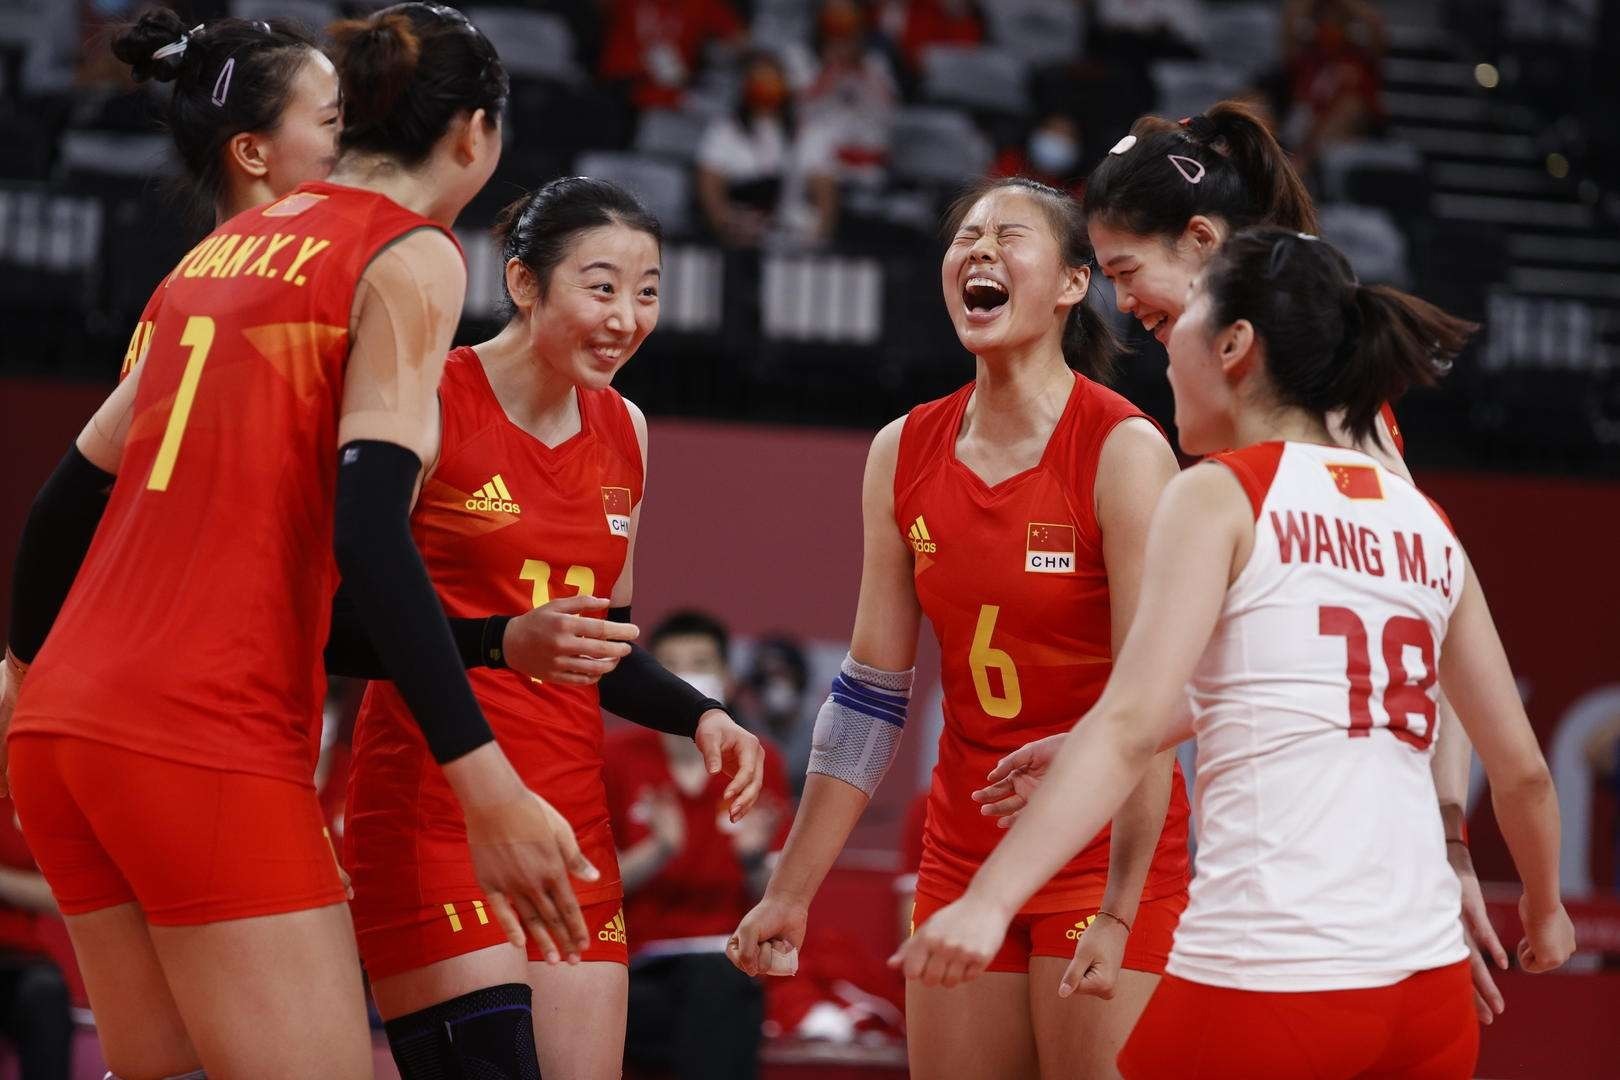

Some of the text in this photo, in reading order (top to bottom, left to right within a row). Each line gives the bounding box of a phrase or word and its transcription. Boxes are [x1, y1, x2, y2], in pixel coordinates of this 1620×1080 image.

[146, 315, 215, 491] 1
[465, 497, 521, 514] adidas
[1270, 510, 1384, 577] WANG
[1031, 555, 1070, 568] CHN
[968, 604, 1022, 719] 6
[1319, 606, 1438, 751] 18
